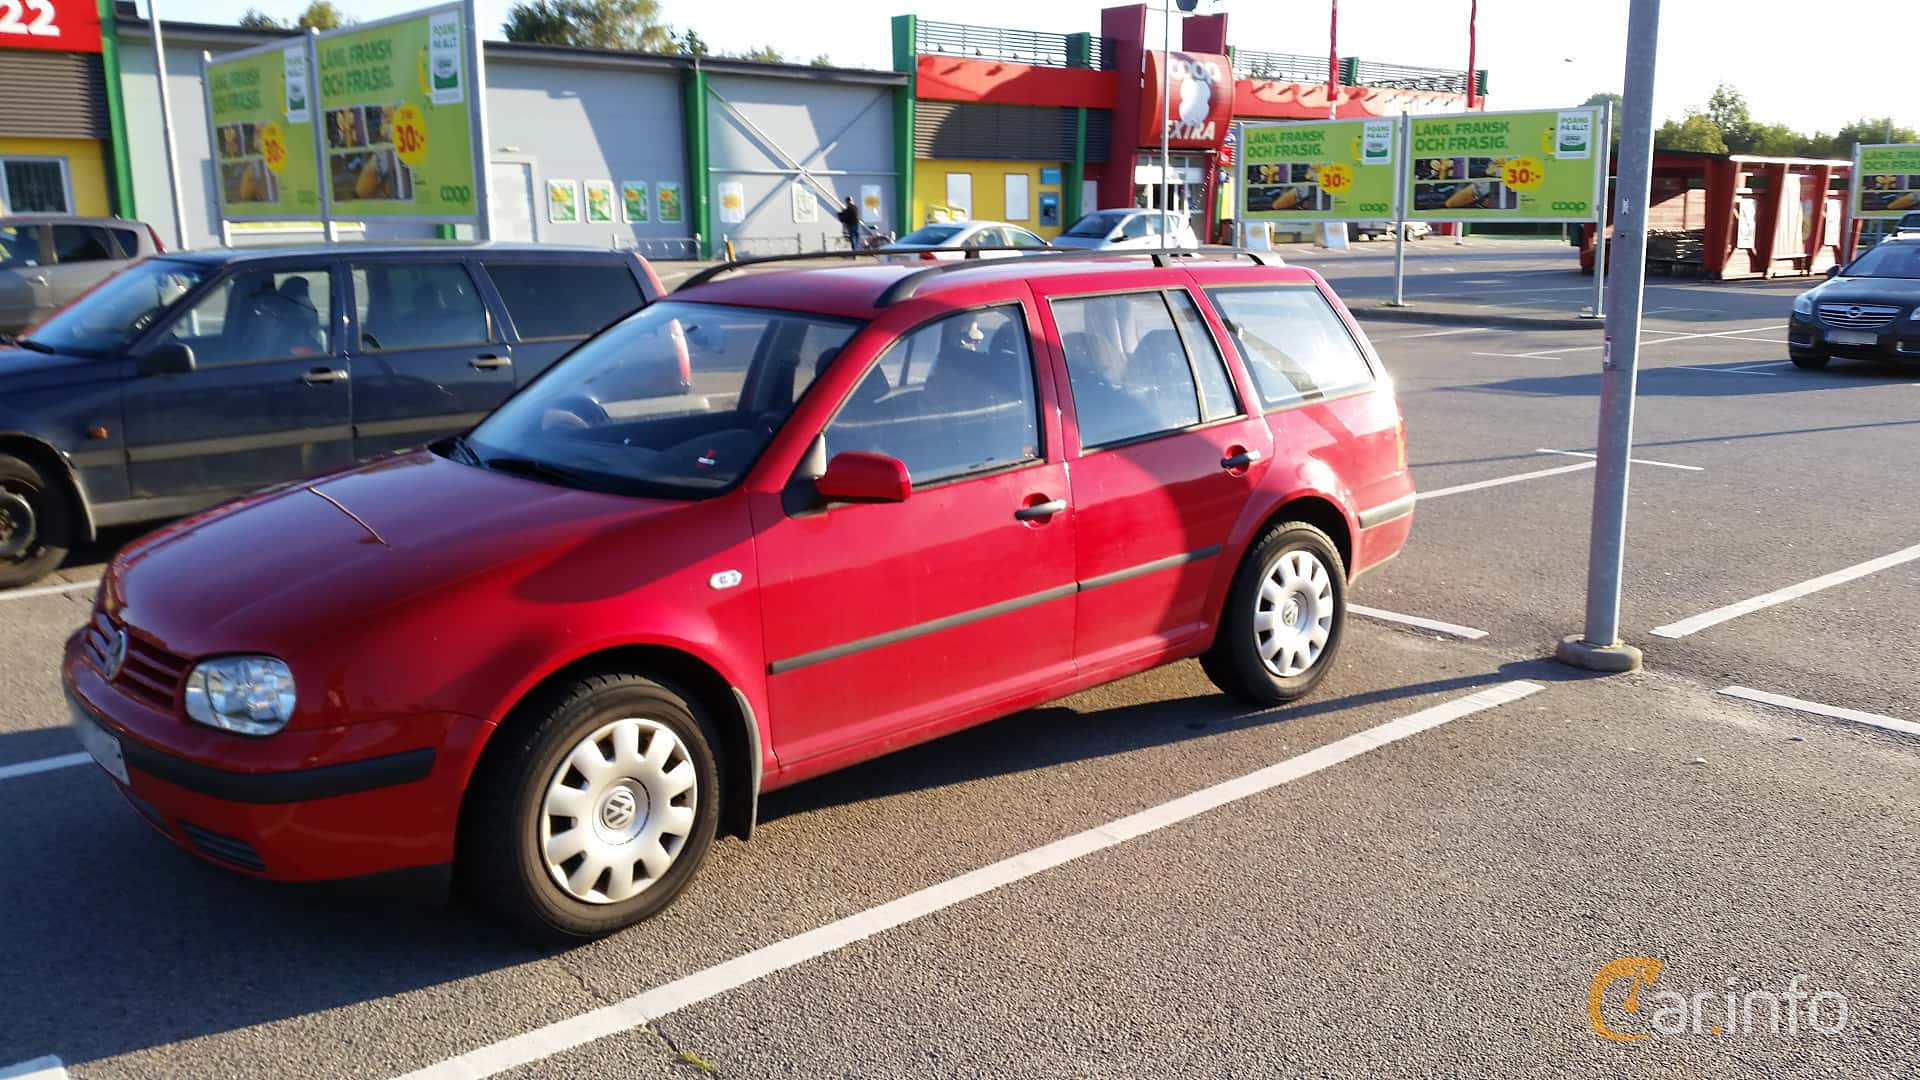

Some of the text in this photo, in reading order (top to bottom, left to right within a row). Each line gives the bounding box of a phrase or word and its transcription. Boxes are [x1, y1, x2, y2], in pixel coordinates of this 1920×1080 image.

[1455, 120, 1510, 134] FRANSK
[1280, 130, 1326, 142] FRANSK
[1415, 137, 1445, 151] OCH
[1248, 145, 1272, 158] OCH
[1323, 172, 1351, 188] 30:-
[1507, 168, 1542, 185] 30:-
